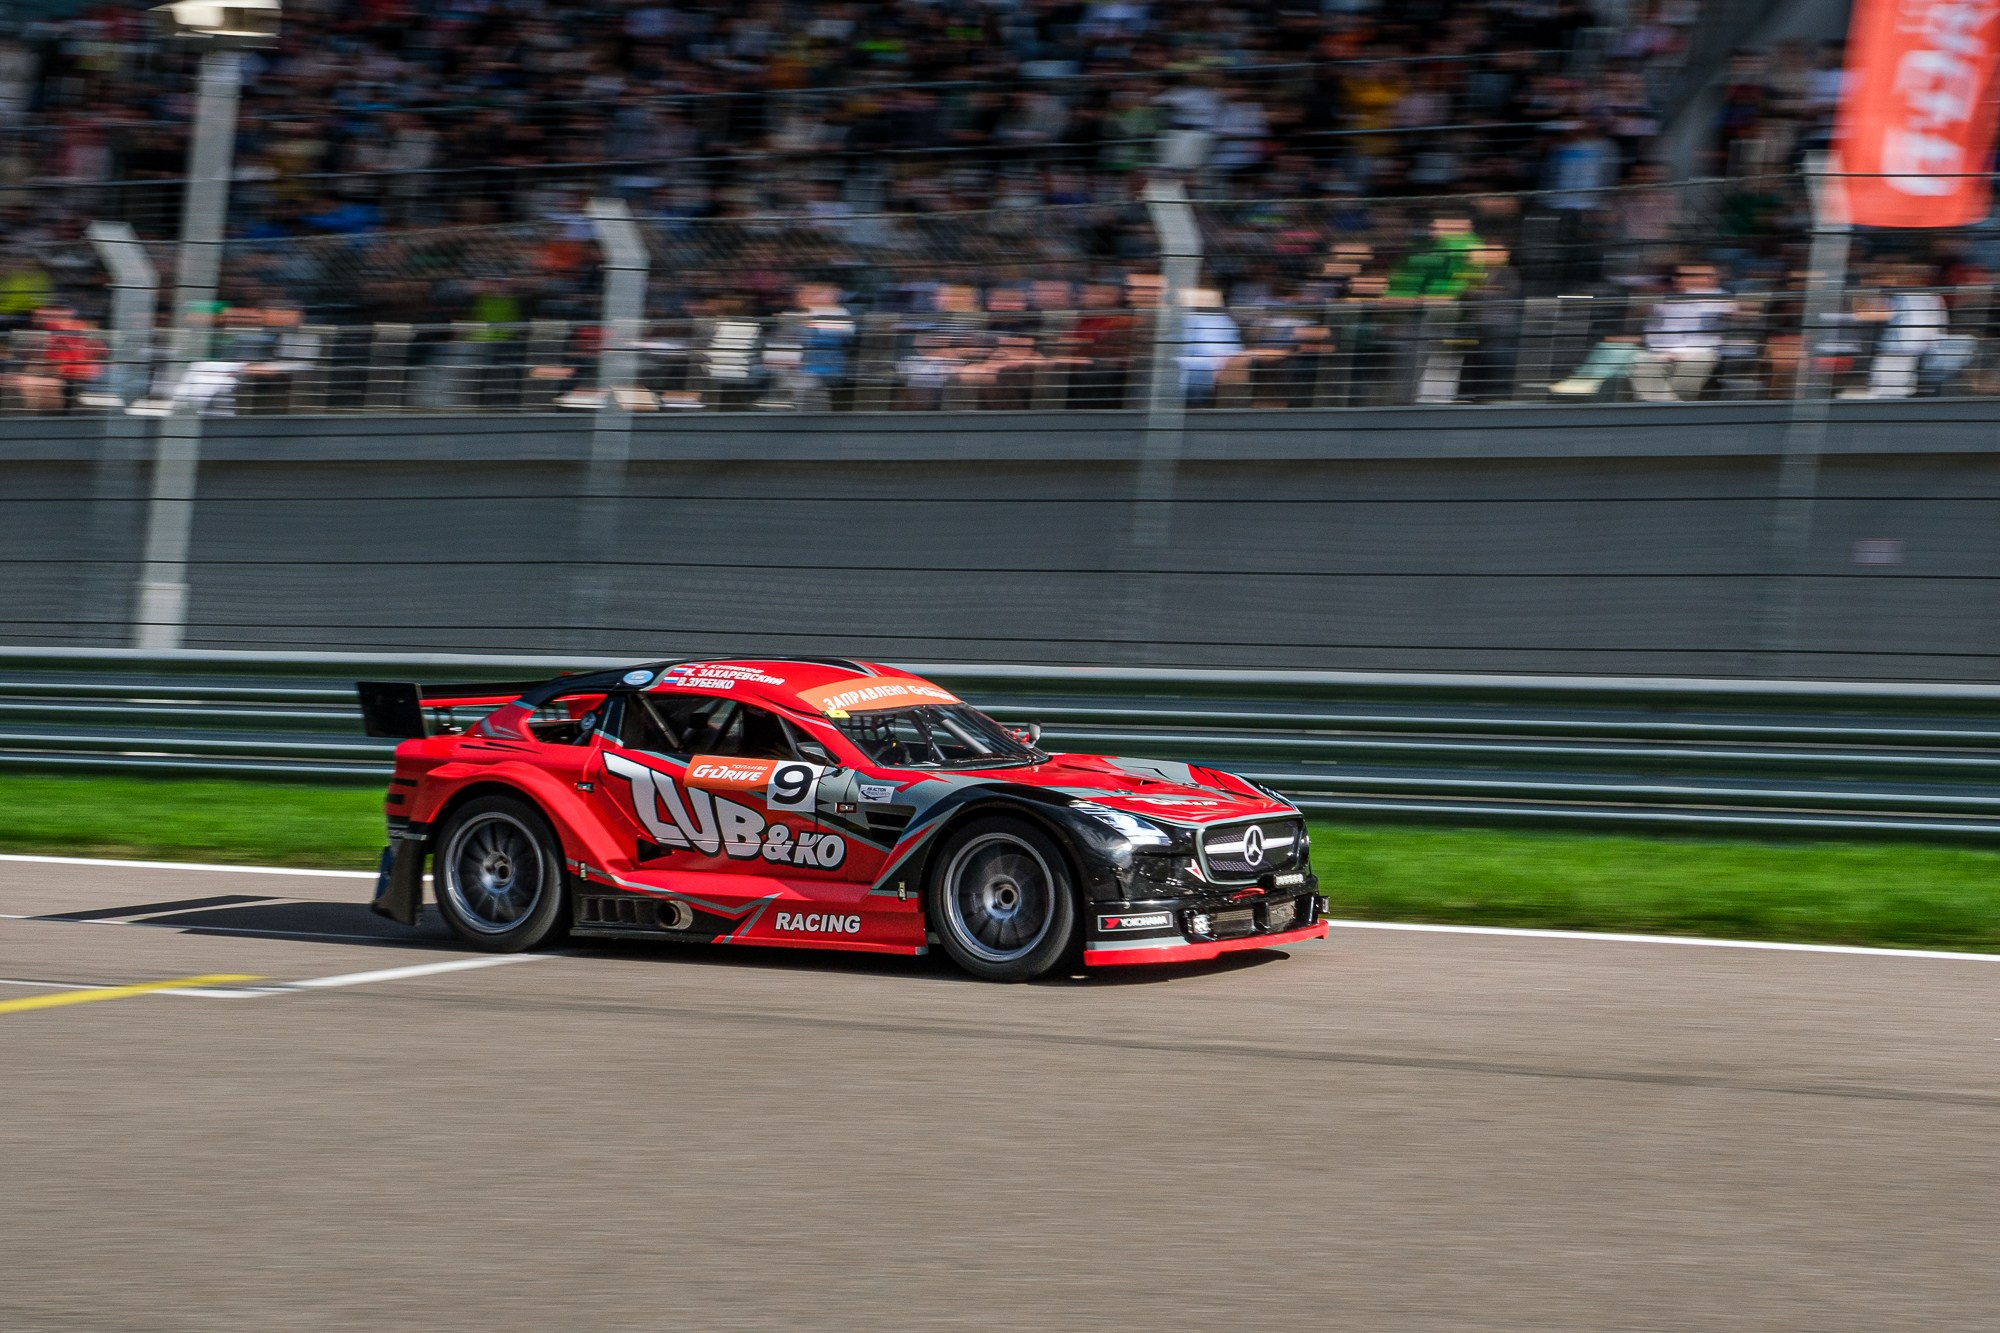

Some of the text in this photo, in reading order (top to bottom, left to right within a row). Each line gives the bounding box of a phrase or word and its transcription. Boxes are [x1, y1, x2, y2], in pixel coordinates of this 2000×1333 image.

[822, 685, 909, 711] ЗАПРАВЛЕНО
[772, 764, 814, 805] 9
[775, 912, 861, 934] RACING
